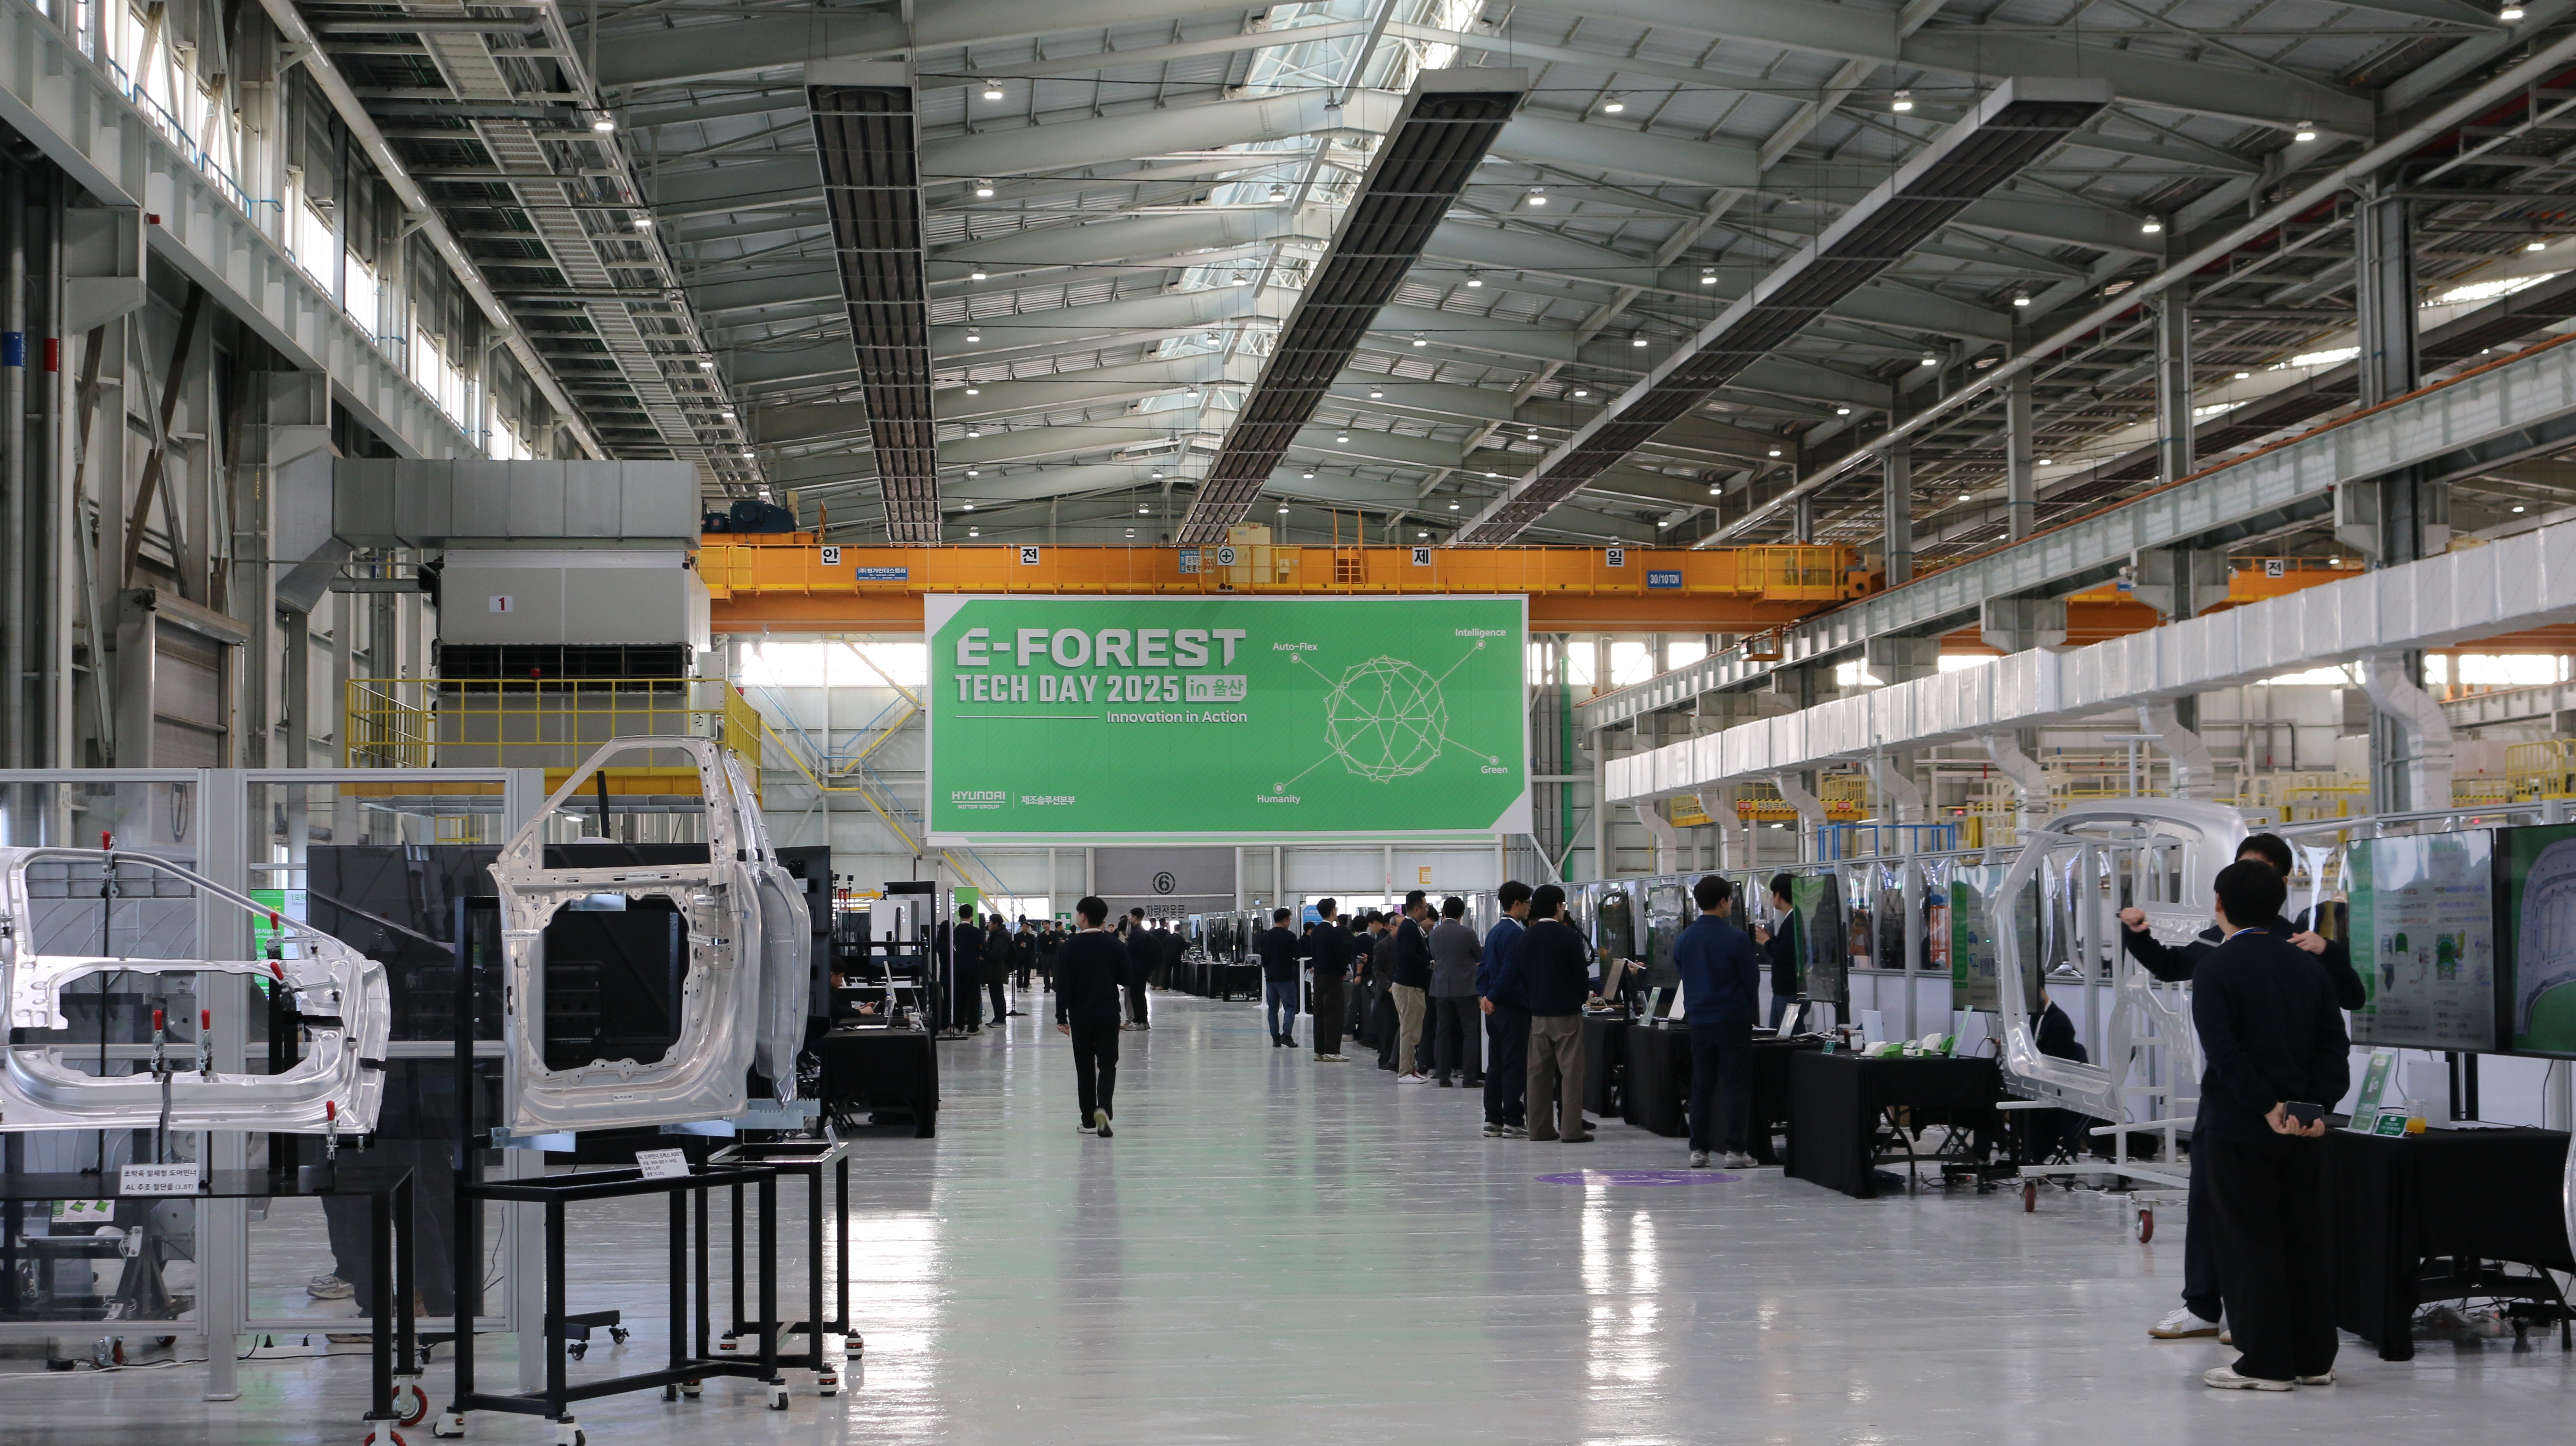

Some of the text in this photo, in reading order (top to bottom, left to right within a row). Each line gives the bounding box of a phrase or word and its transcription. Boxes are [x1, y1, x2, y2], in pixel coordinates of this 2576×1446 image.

[823, 547, 1622, 565] 안 전 제 일
[2267, 562, 2282, 577] 전
[498, 597, 505, 611] 1
[1455, 628, 1506, 638] Intelligence
[957, 628, 1247, 667] E-FOREST
[1272, 642, 1318, 651] Auto-Flex
[955, 675, 1243, 702] TECH DAY 2025 in 울산
[1107, 711, 1247, 723] Innovation in Action
[1481, 766, 1508, 774] Green
[952, 791, 1006, 800] HYUNDAI
[1021, 795, 1076, 805] 제조솔루션본부
[1256, 795, 1301, 804] Humanity
[1146, 904, 1185, 919] 차량전용문
[153, 1183, 174, 1191] 절단품
